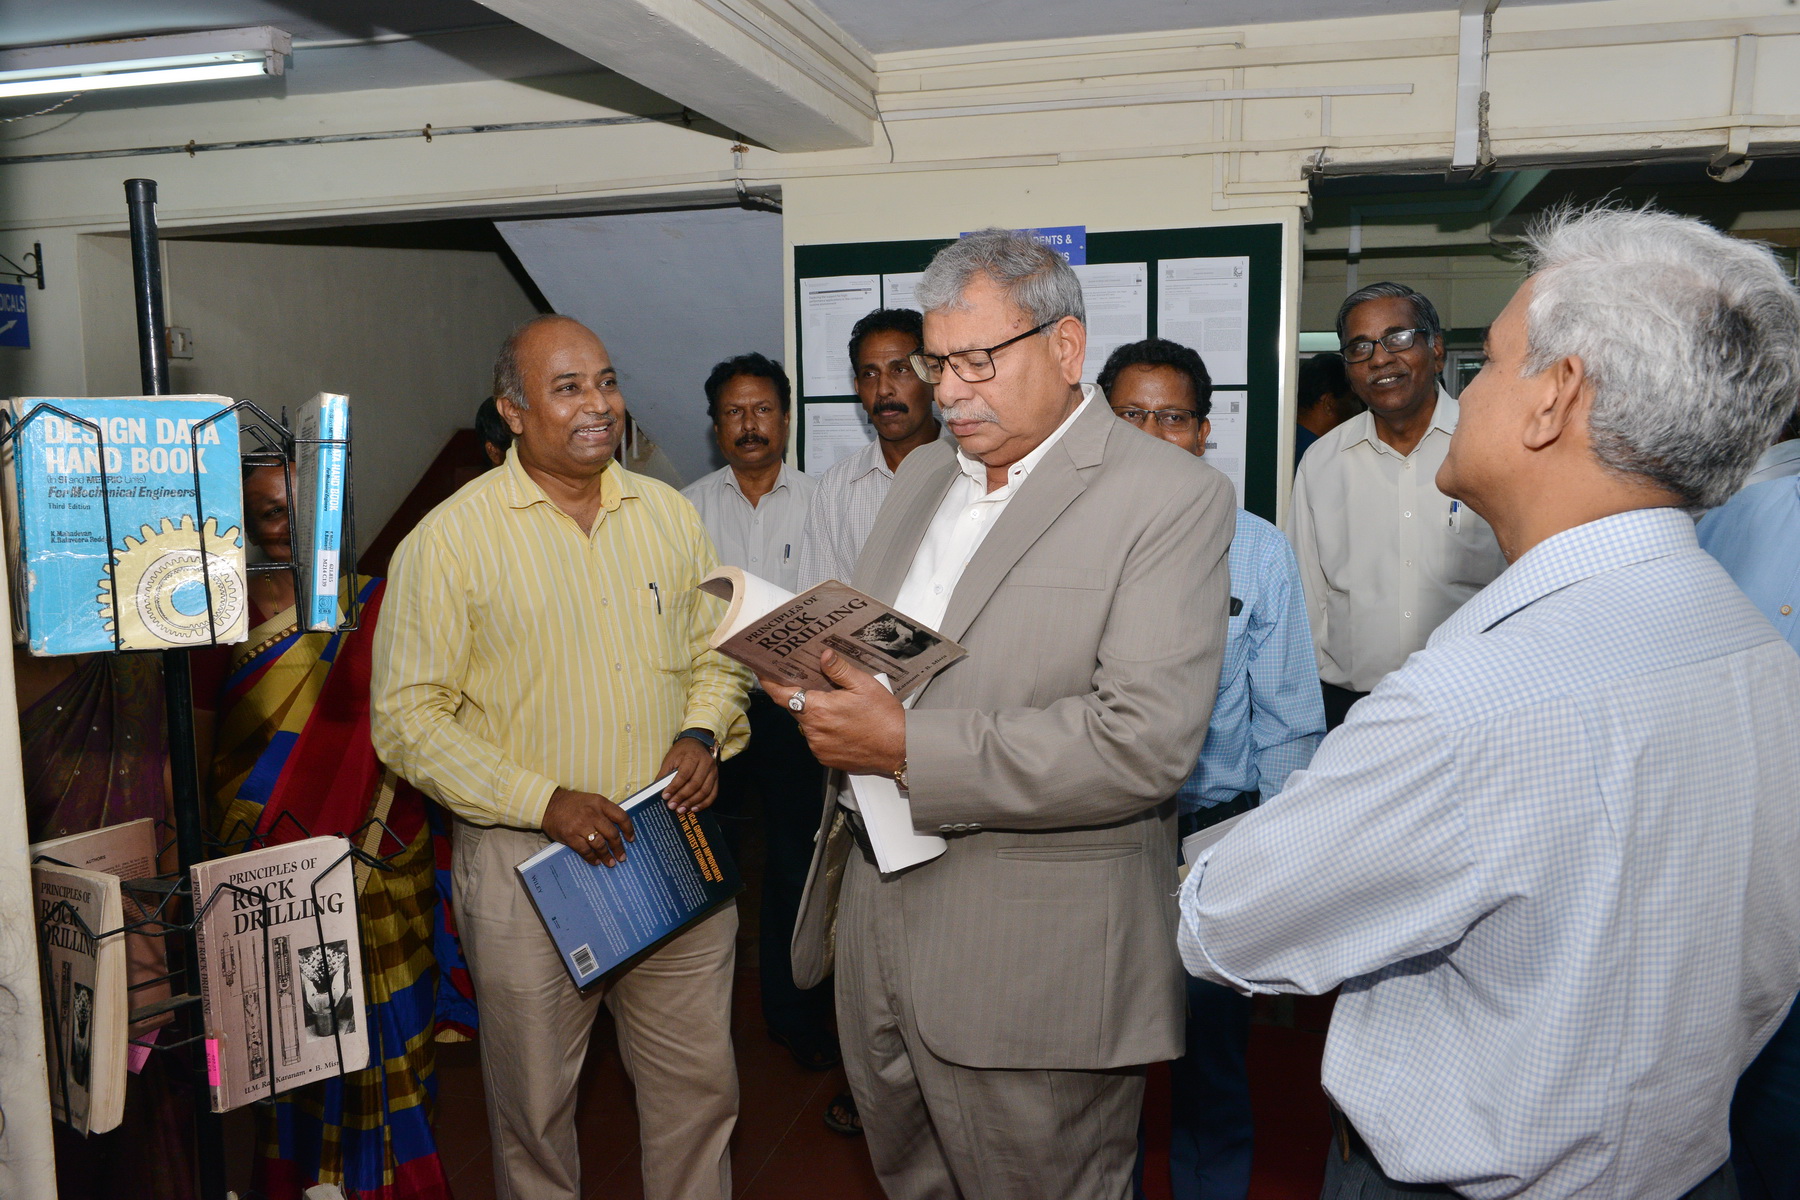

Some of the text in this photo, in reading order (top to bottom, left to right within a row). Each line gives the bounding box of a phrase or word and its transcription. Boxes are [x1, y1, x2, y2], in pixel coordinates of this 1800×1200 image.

[1065, 234, 1072, 244] &
[44, 417, 220, 445] DESIGN DATA
[45, 447, 208, 474] HAND BOOK
[68, 476, 84, 484] and
[86, 475, 123, 484] MERIC
[330, 464, 340, 486] HAND
[48, 486, 196, 500] For Mechnical Engineers
[48, 502, 66, 510] Third
[328, 489, 339, 511] BOOK
[745, 595, 819, 642] PRINCIPLES OF
[756, 612, 818, 651] ROCK
[771, 598, 868, 658] DRILLING
[681, 820, 692, 833] THE
[685, 830, 699, 850] LATEST
[693, 824, 708, 848] GROUND
[703, 845, 724, 883] IMPROVEMENT
[693, 848, 714, 882] TECHNOLOGY
[229, 857, 317, 885] PRINCIPLES OF
[41, 882, 91, 904] PRINCIPLES OF
[231, 878, 296, 912] ROCK
[41, 899, 79, 927] ROCK
[234, 892, 344, 936] DRILLING
[43, 924, 97, 961] DRILLING
[197, 934, 205, 945] OF
[198, 949, 208, 973] ROCK
[200, 973, 211, 1015] DRILLING
[275, 1070, 306, 1083] Karanam
